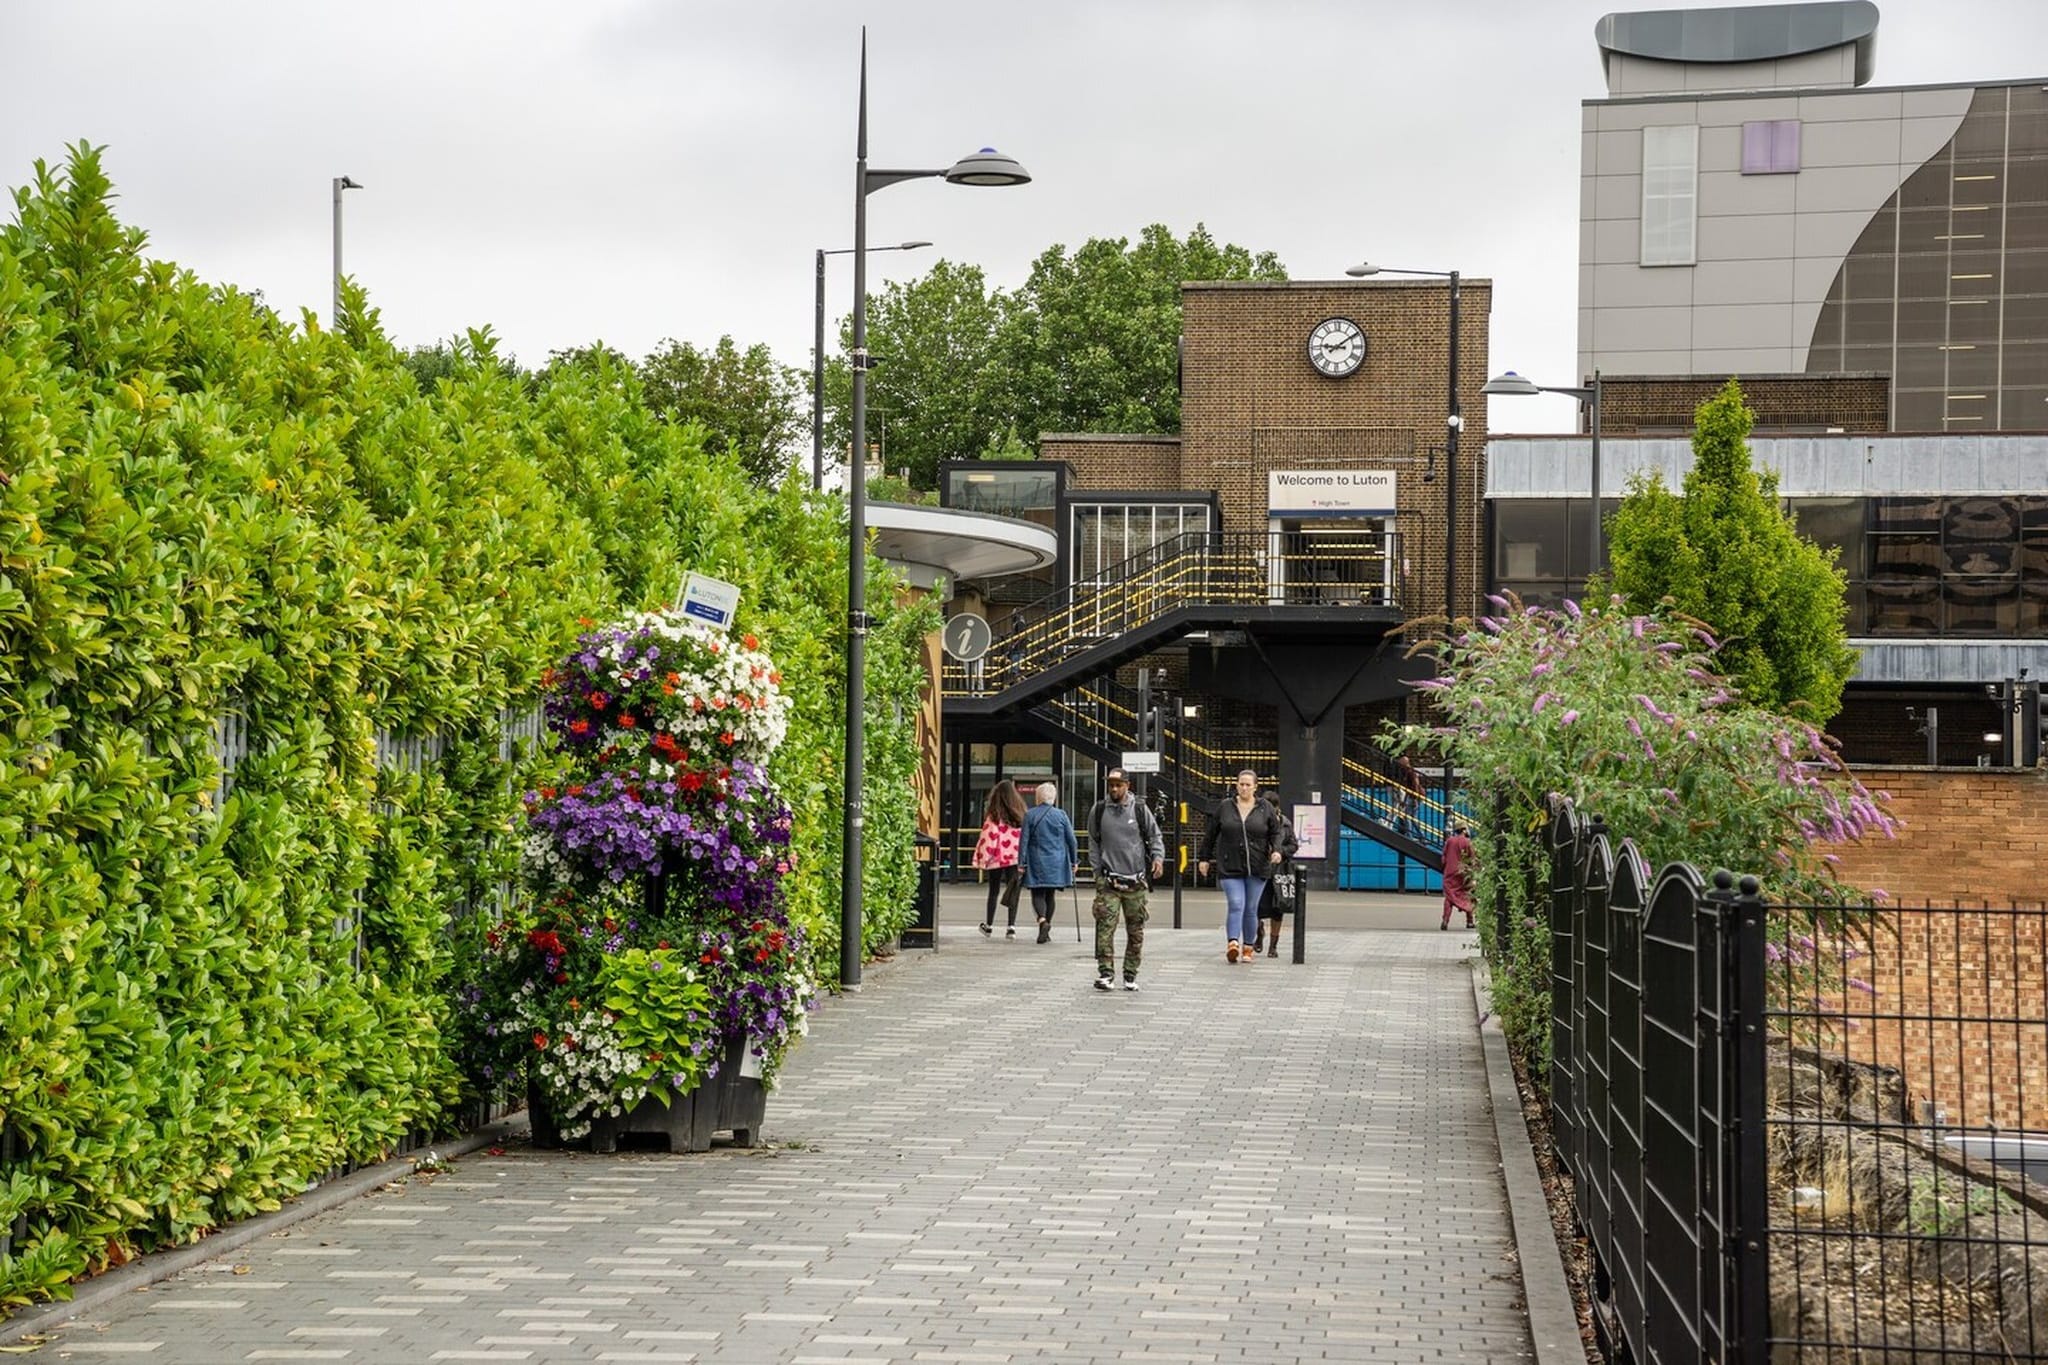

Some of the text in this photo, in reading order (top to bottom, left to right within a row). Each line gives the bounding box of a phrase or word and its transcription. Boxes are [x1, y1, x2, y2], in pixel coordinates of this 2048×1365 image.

[1277, 475, 1387, 485] Welcome to Luton
